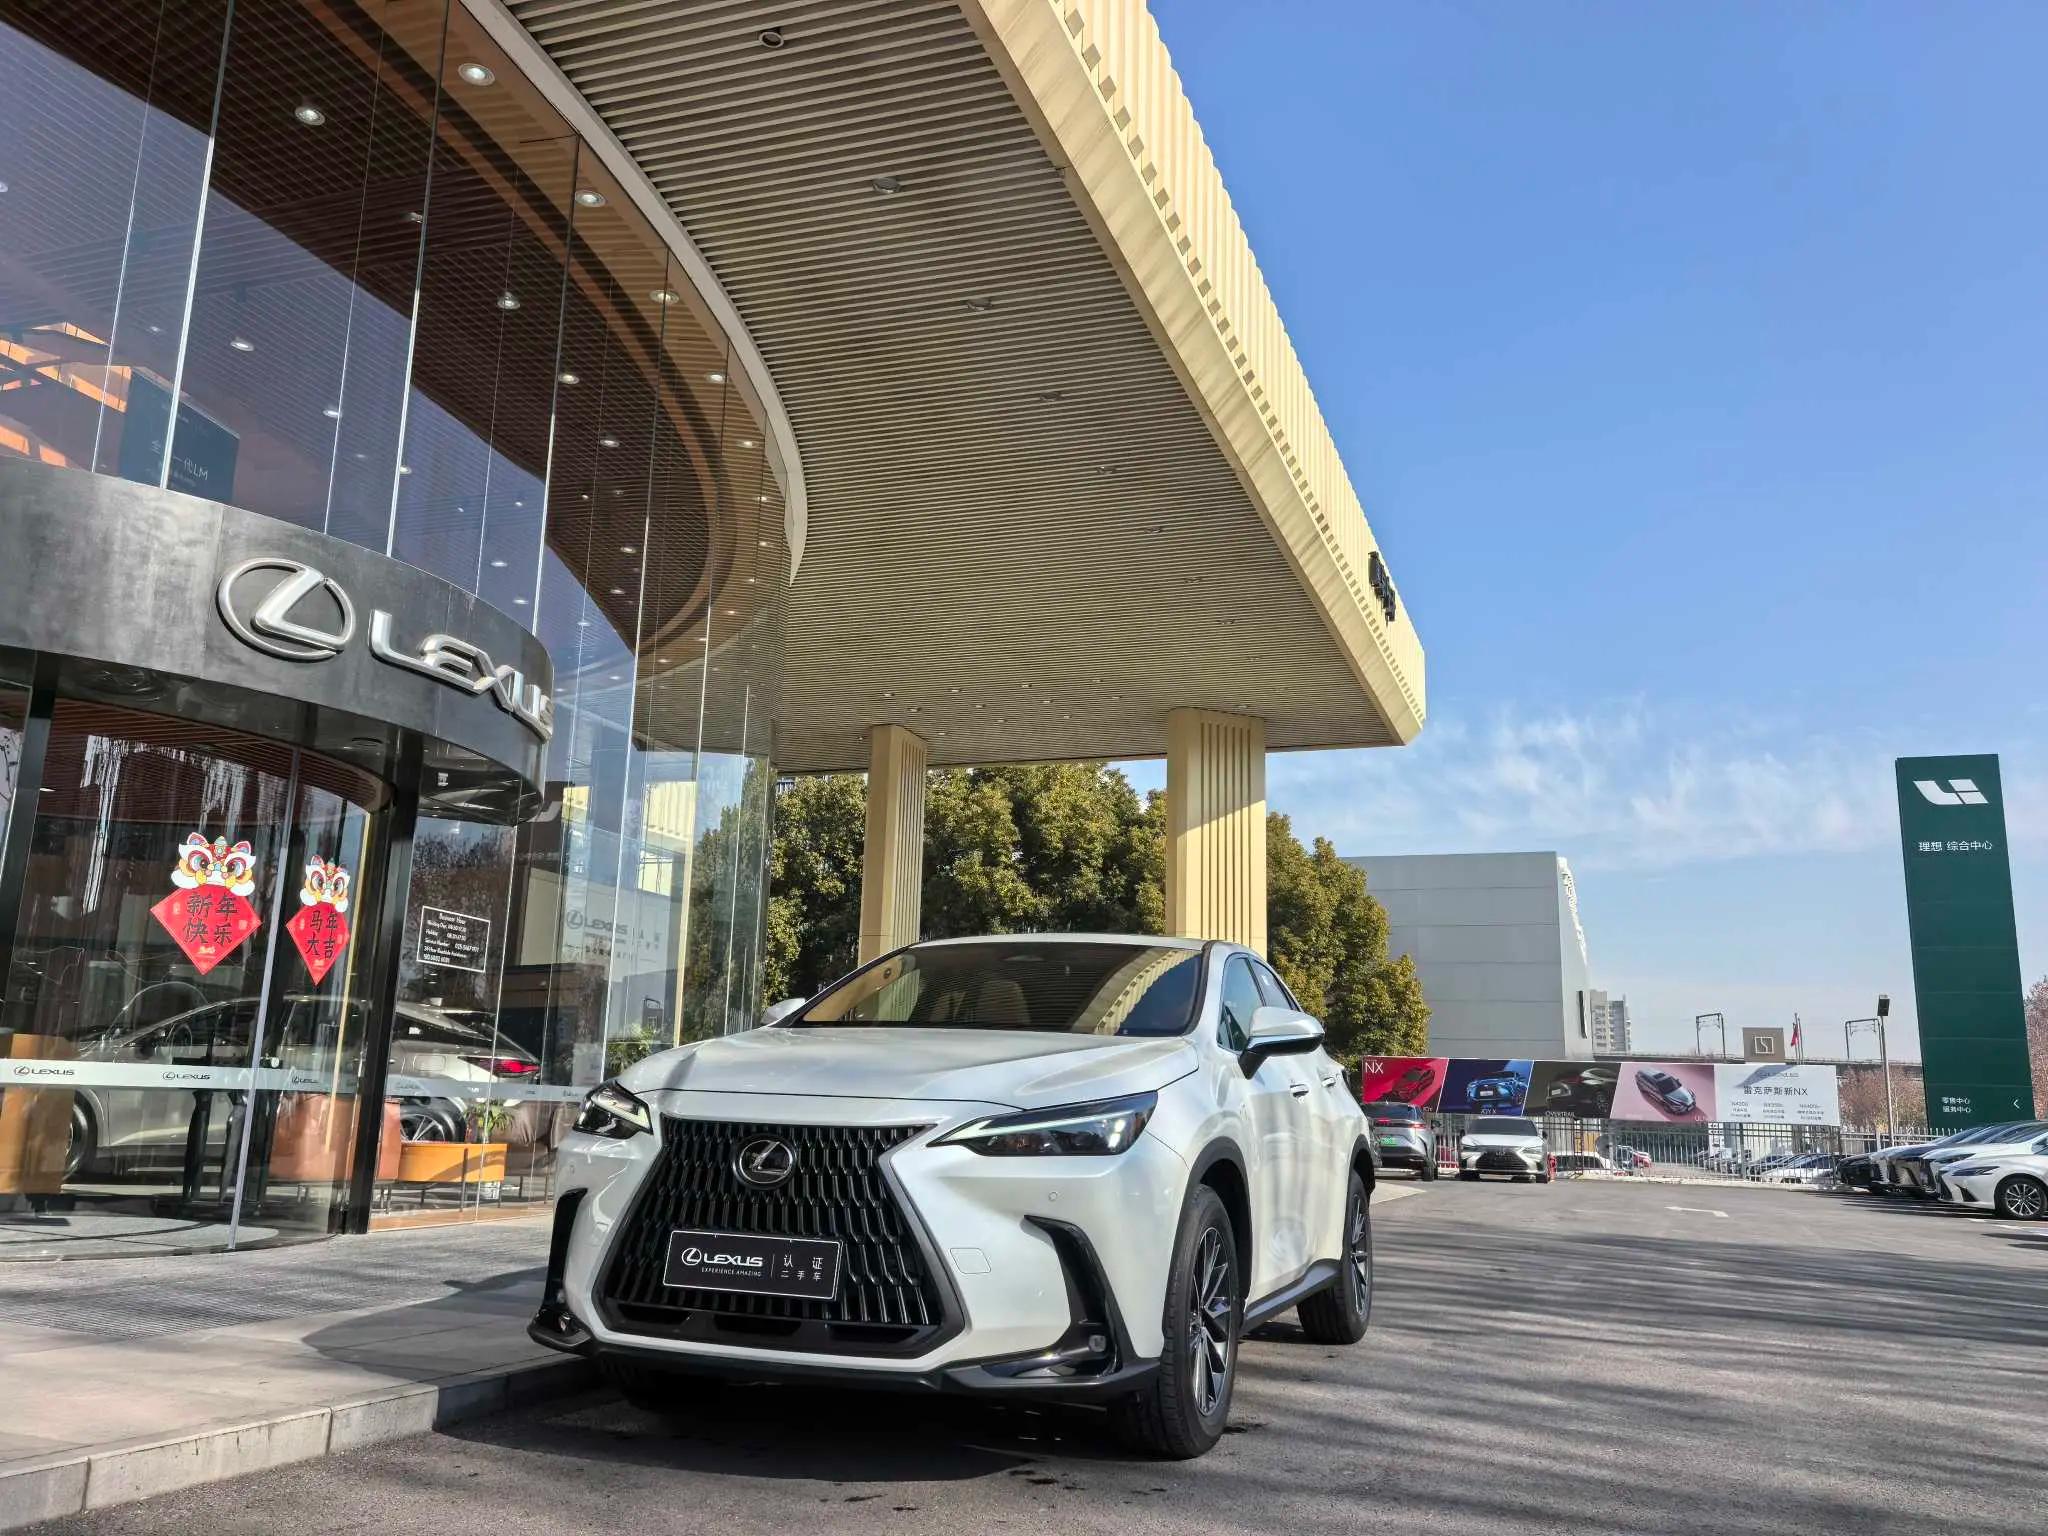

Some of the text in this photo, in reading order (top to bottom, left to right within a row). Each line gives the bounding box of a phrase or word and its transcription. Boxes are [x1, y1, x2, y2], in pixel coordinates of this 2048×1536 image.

[1918, 840, 1993, 852] 理想 综合中心
[187, 892, 237, 921] 新年
[310, 910, 338, 937] 马年
[183, 919, 233, 946] 快乐
[305, 932, 335, 960] 大吉
[1365, 1062, 1384, 1074] NX
[703, 1252, 763, 1267] LEXUS
[783, 1254, 824, 1270] 认证
[701, 1267, 762, 1277] EXPERIENCE AMAZING
[780, 1270, 822, 1282] 二手车
